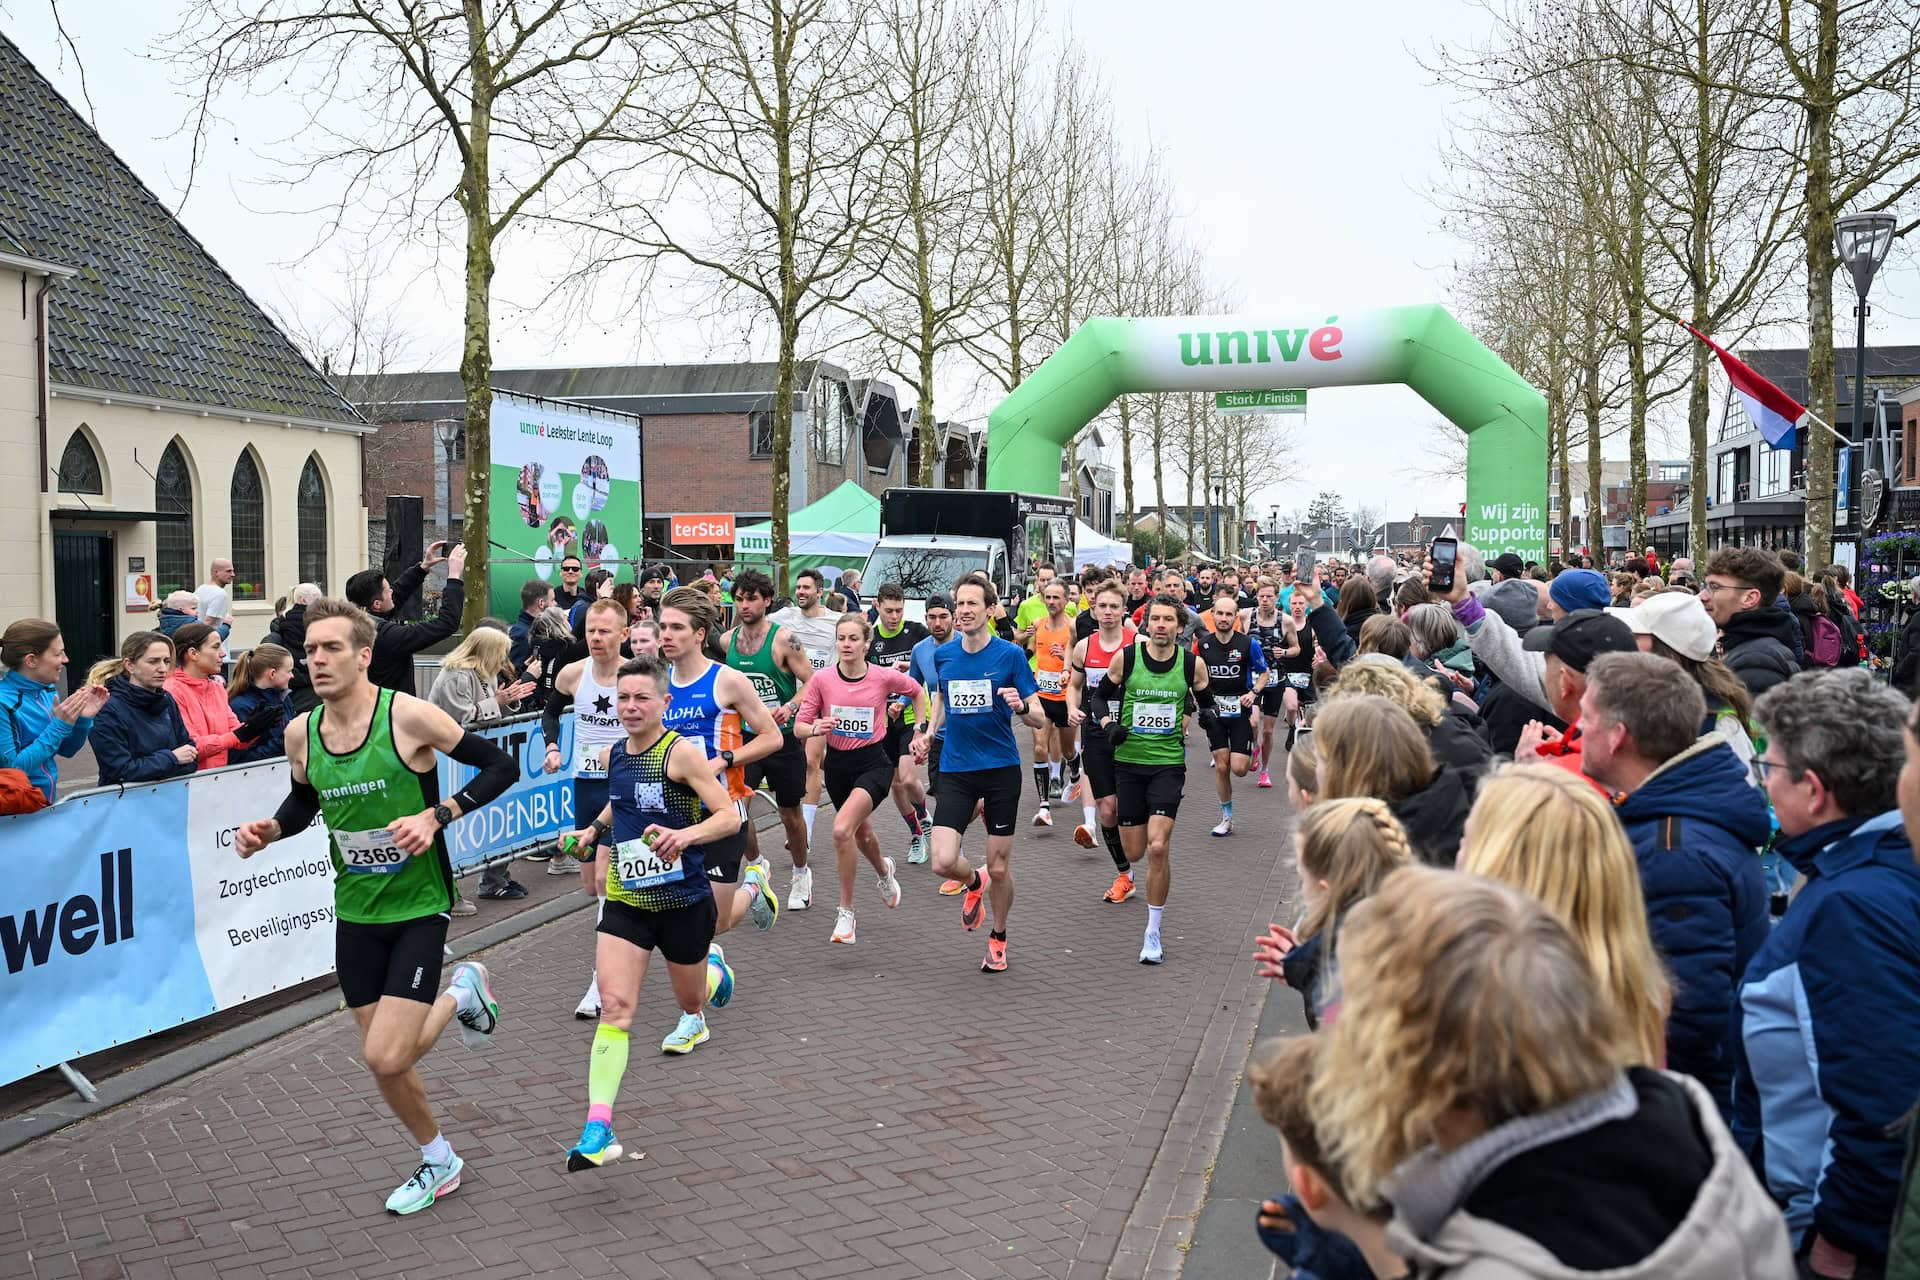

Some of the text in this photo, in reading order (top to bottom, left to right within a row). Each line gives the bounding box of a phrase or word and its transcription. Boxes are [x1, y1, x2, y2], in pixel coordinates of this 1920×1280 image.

[1178, 315, 1343, 366] univé
[1225, 394, 1254, 406] Start
[1264, 392, 1297, 404] Finish
[520, 420, 613, 450] univé Leekster Lente Loop
[1481, 502, 1539, 524] Wij zijn
[675, 522, 731, 537] terStal
[1471, 524, 1545, 545] Supporter
[1480, 549, 1499, 561] an
[1210, 665, 1240, 676] BDO
[953, 694, 986, 707] 2323
[1136, 688, 1178, 698] groningen
[836, 719, 868, 732] 2605
[1138, 716, 1171, 728] 2265
[321, 778, 386, 801] groningen
[348, 846, 401, 865] 2366
[219, 854, 331, 899] Zorgtechnologi
[0, 847, 135, 975] well
[227, 905, 334, 947] Beveiligingssy
